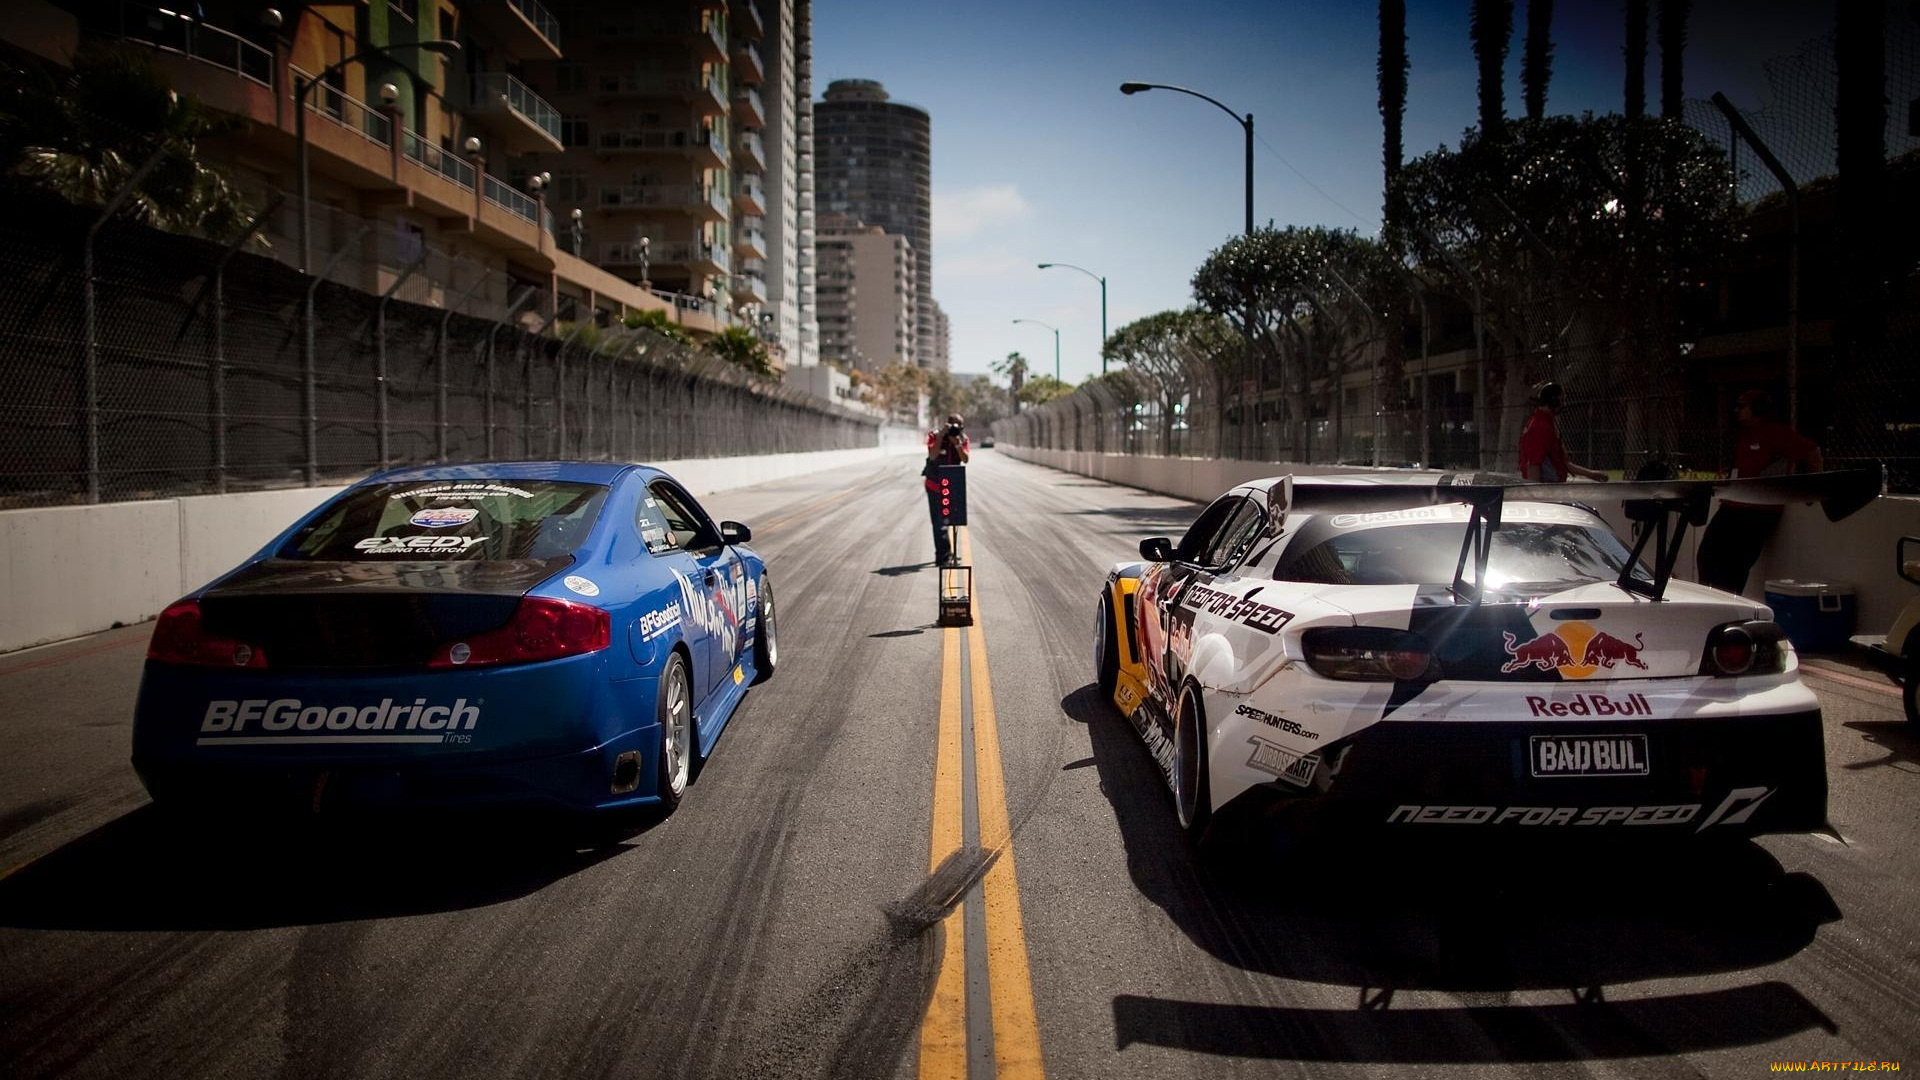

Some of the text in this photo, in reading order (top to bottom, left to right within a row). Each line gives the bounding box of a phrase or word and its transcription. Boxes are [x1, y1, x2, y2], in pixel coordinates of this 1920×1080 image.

[390, 485, 451, 499] Ultimate
[1360, 507, 1436, 523] Castrol
[354, 535, 490, 549] EXEDY
[640, 599, 681, 636] BFGoodrich
[1182, 585, 1296, 635] NEED FOR SPEED
[200, 698, 480, 732] BFGoodrich
[1526, 693, 1653, 717] Red Bull
[1235, 704, 1319, 740] SPEEDHUNTERS.com
[444, 732, 472, 744] Tires
[1387, 804, 1702, 826] NEED FOR SPEED
